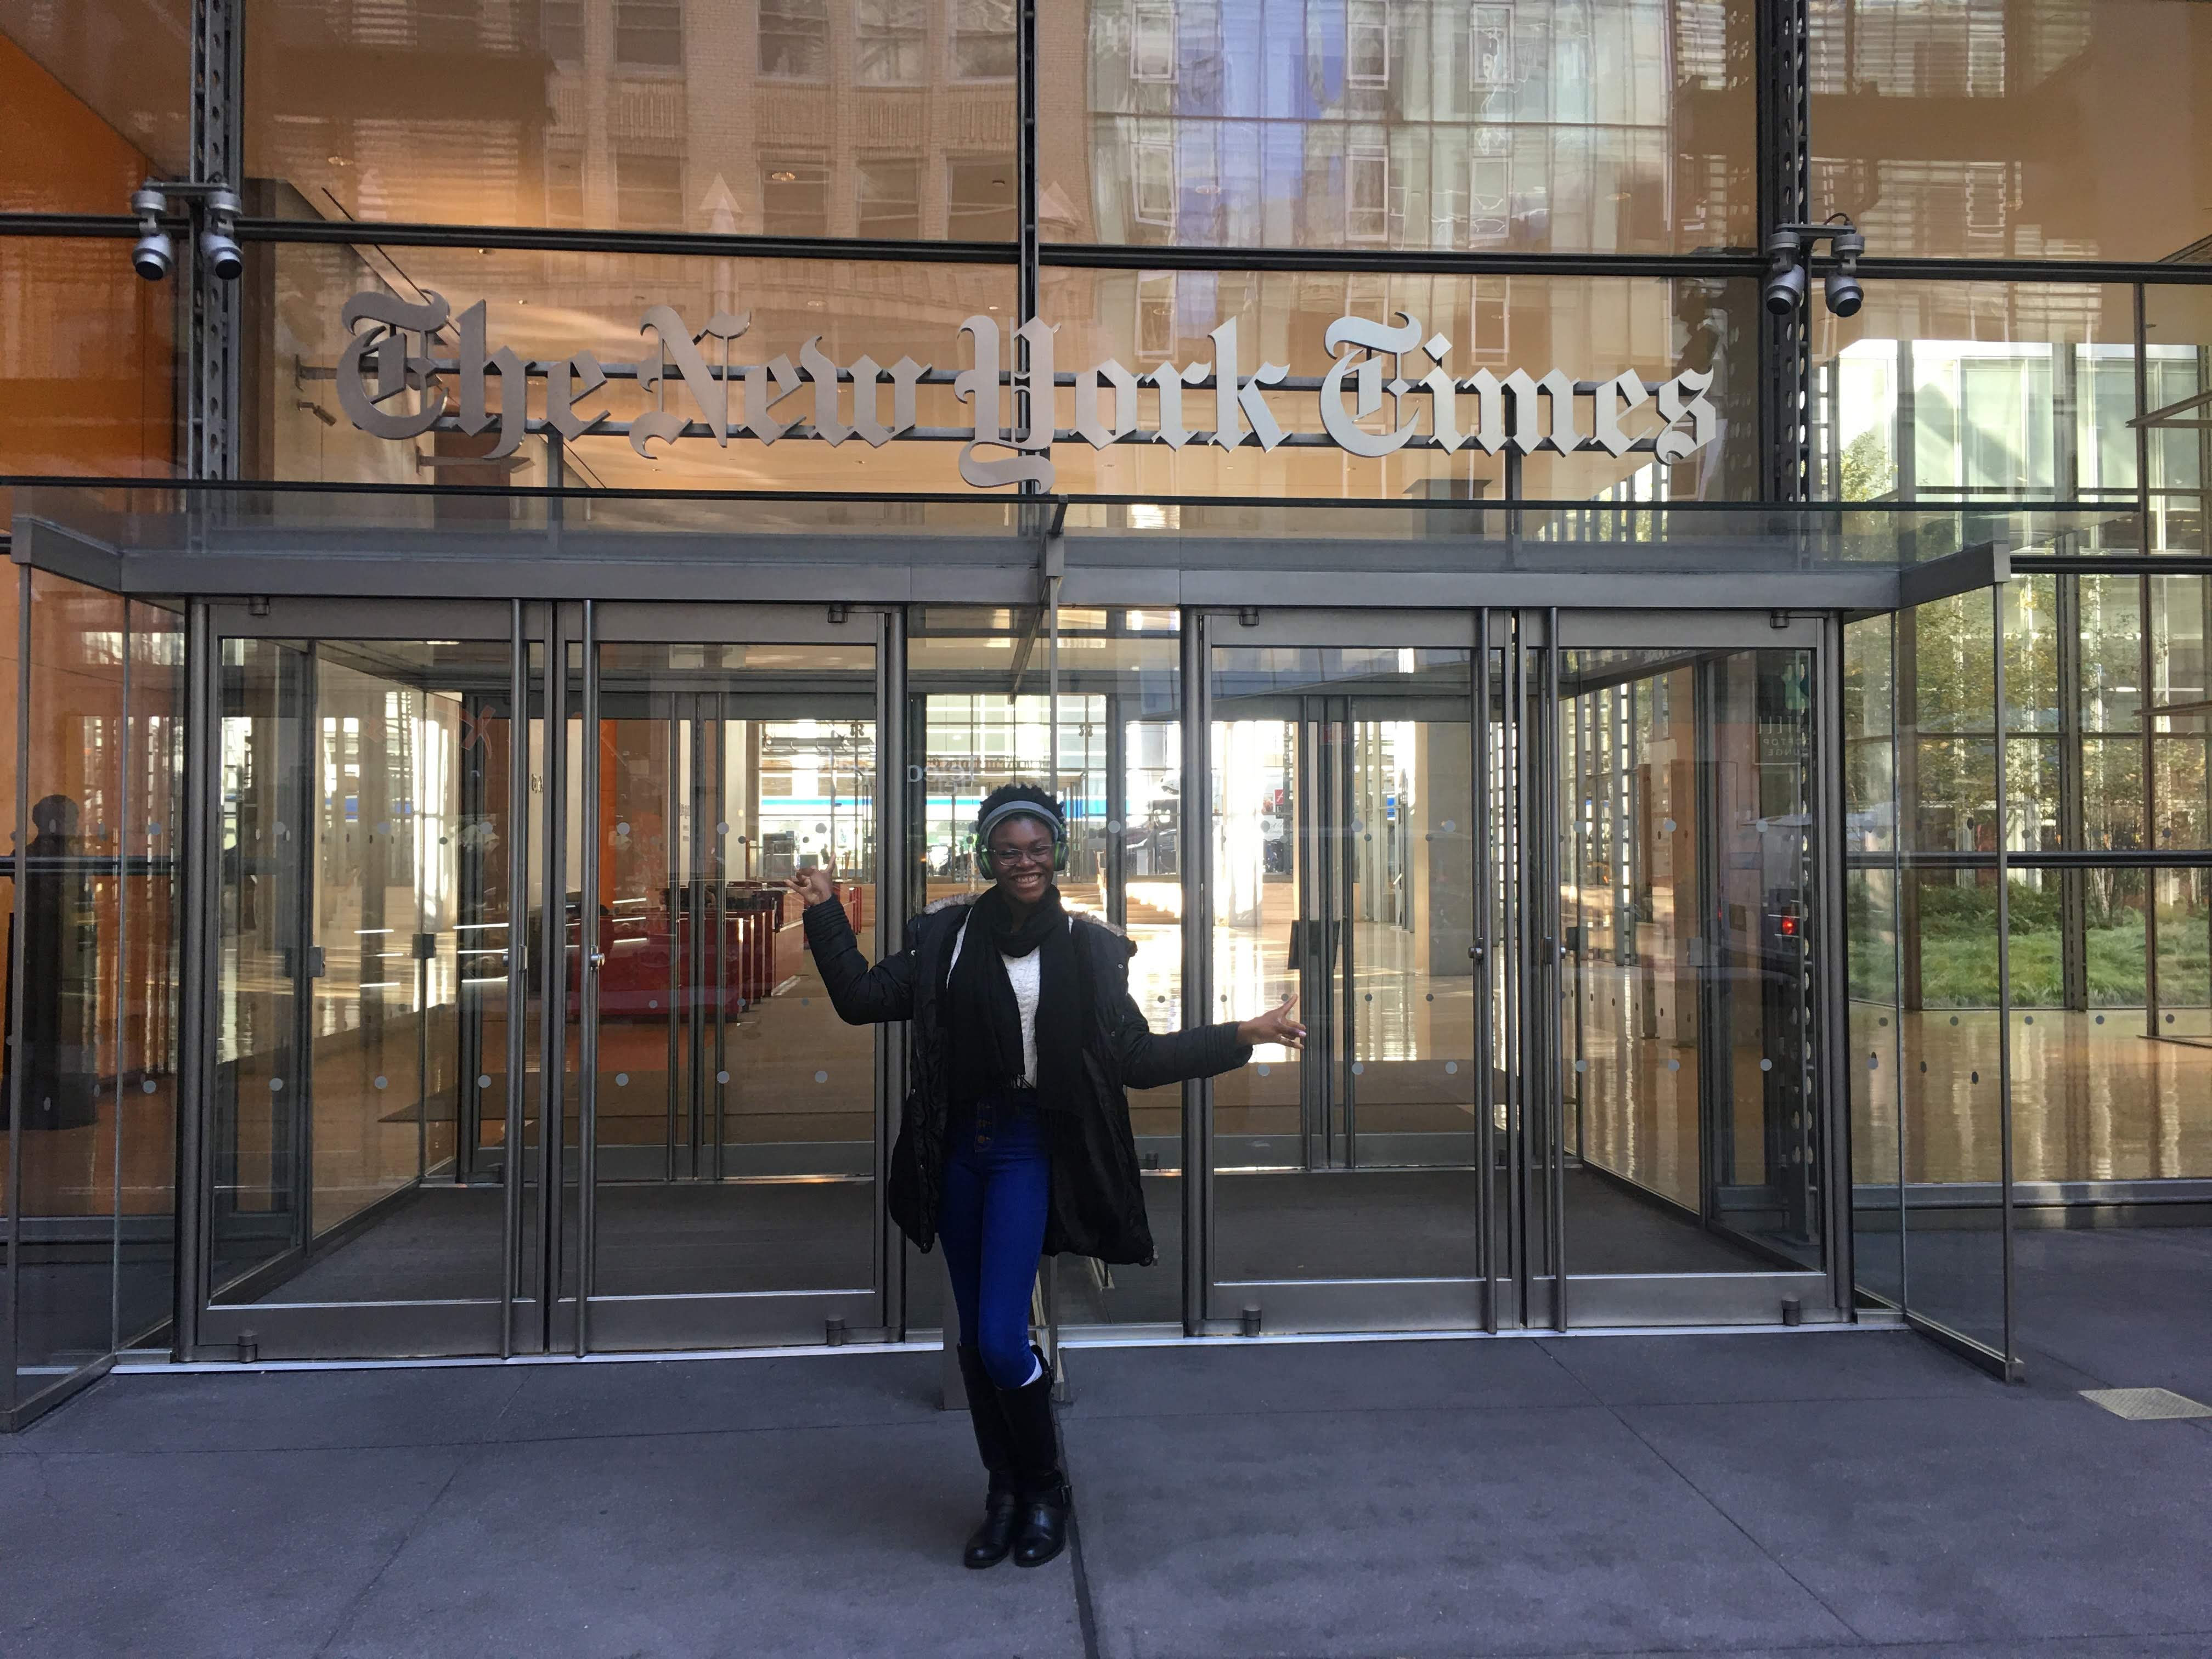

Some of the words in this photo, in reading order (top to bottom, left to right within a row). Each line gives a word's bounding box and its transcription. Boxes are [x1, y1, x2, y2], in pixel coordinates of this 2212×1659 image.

[336, 289, 611, 459] The
[628, 305, 931, 459] New
[954, 315, 1293, 494] York
[1319, 311, 1716, 466] Times
